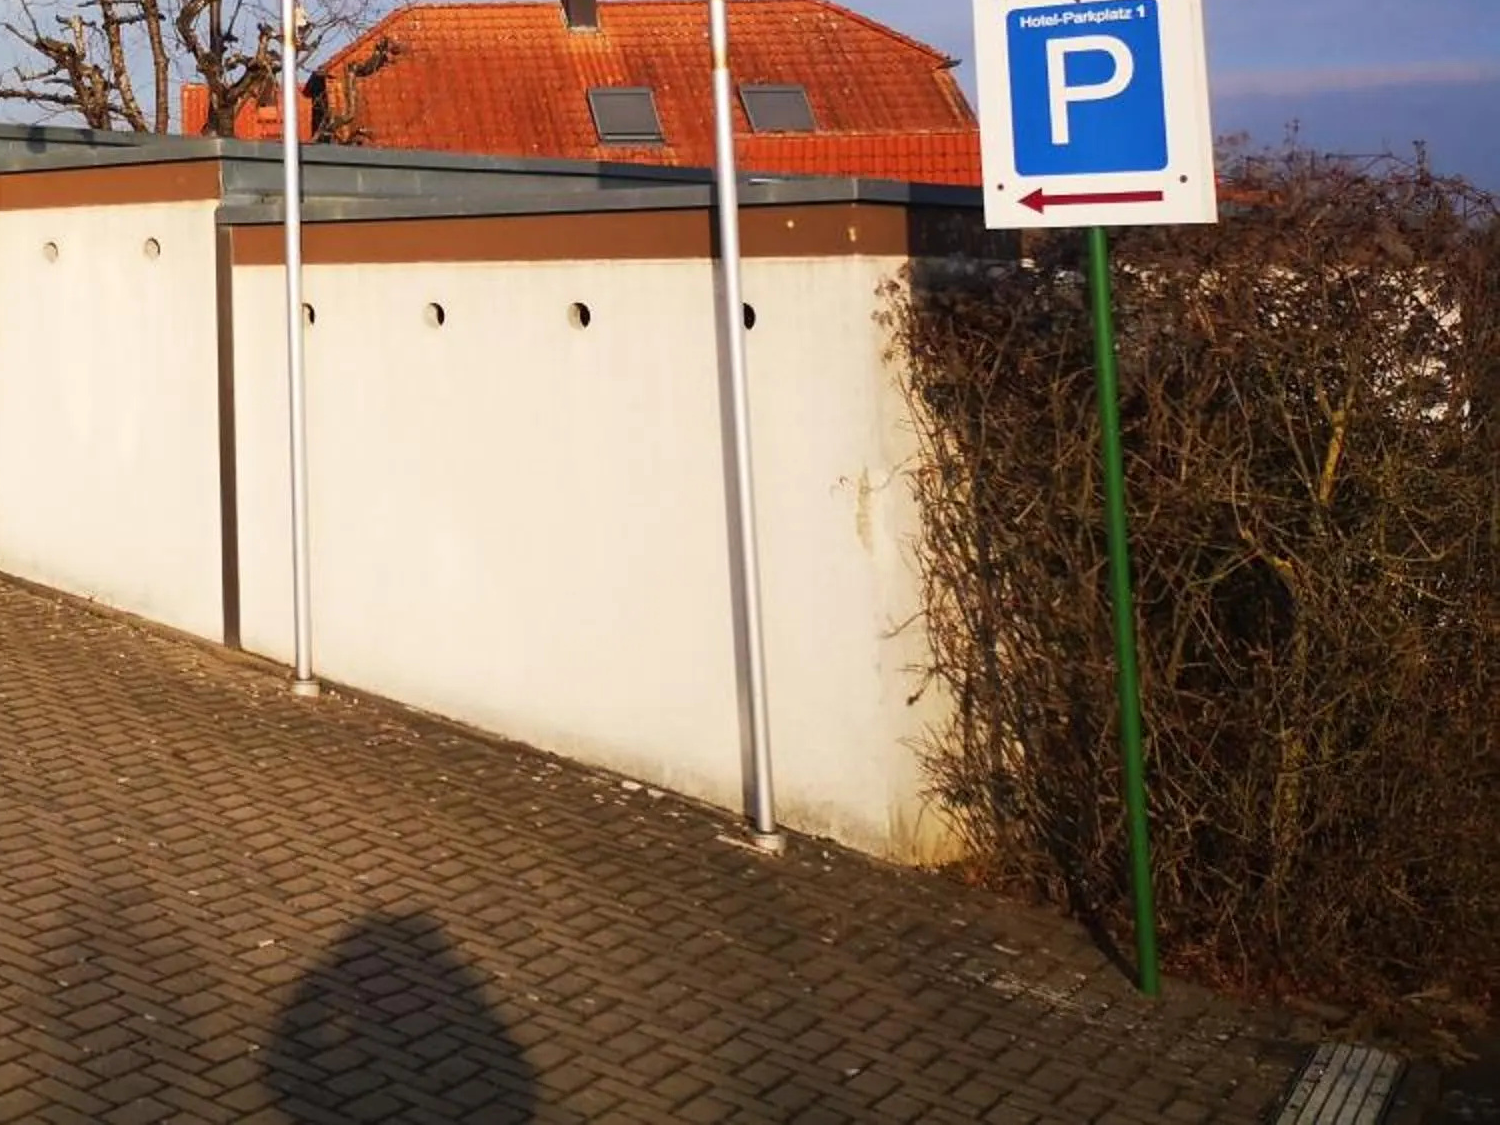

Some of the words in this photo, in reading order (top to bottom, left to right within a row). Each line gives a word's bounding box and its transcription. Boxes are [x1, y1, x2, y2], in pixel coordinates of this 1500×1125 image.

[1019, 7, 1133, 29] Hotel-Parkplatz
[1136, 4, 1146, 18] 1
[1046, 34, 1134, 145] P
